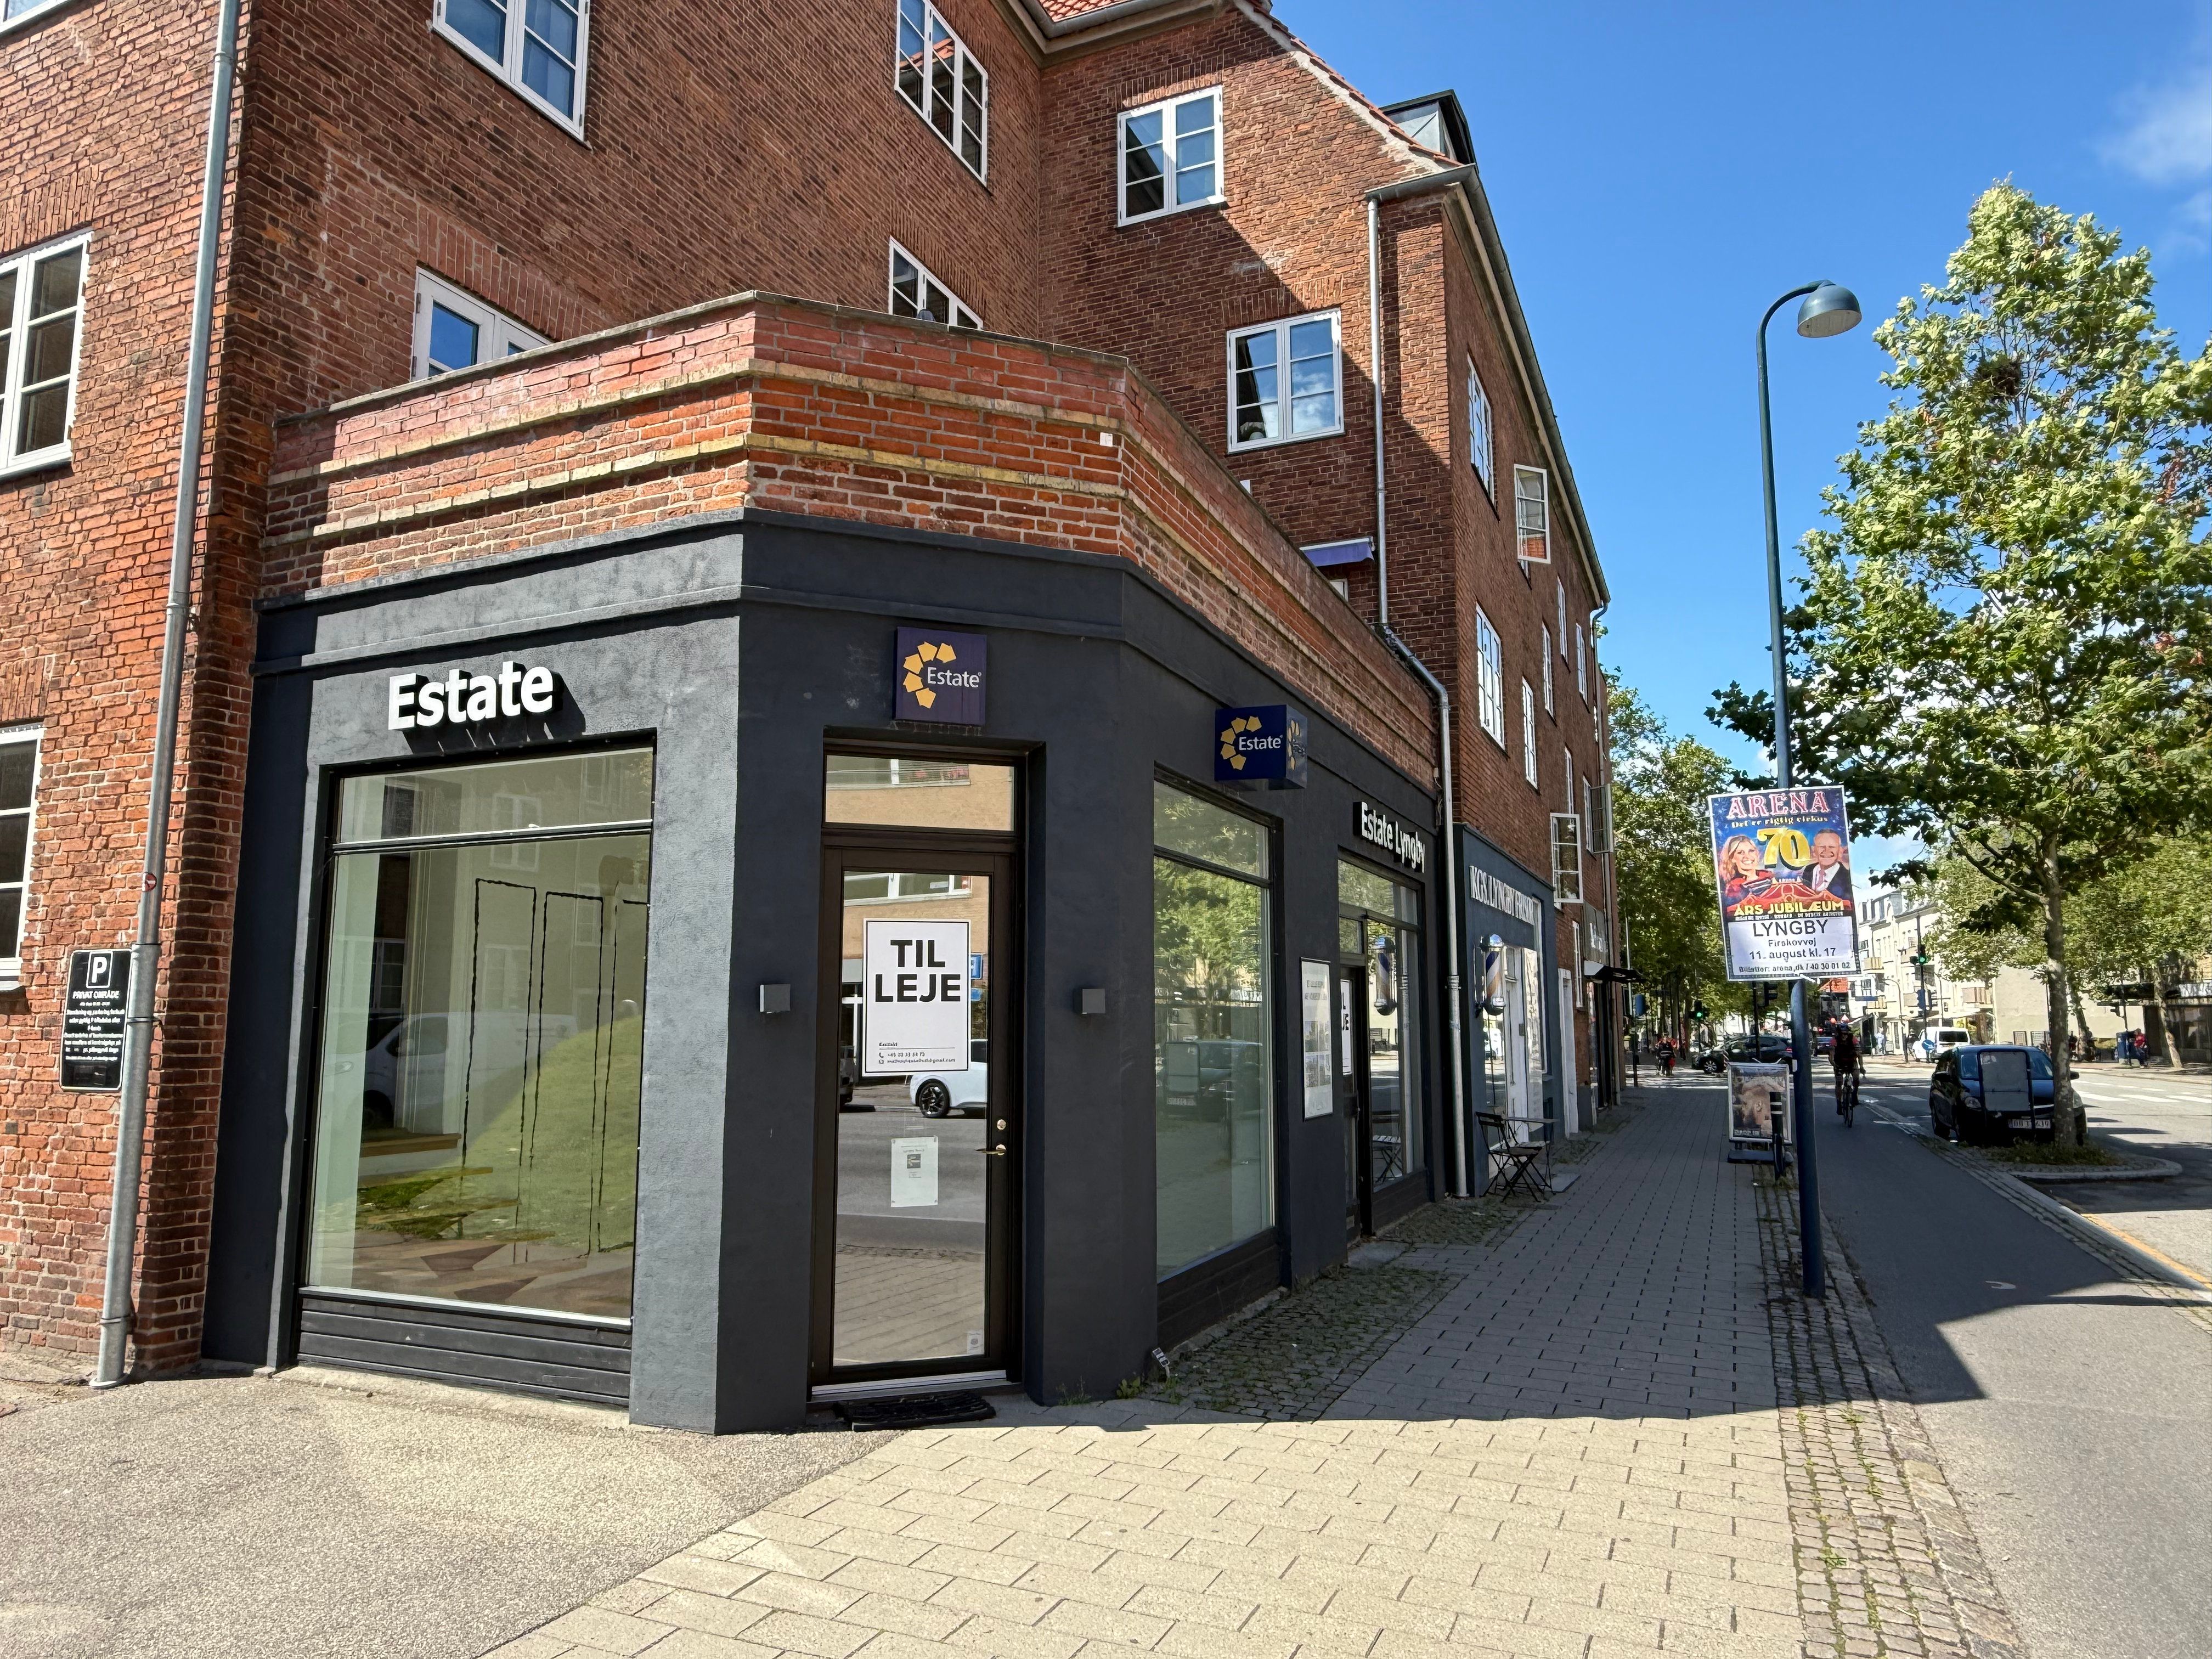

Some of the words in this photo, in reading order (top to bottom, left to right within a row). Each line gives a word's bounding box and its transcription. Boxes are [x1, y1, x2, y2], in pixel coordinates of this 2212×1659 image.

[927, 667, 980, 688] Estate
[388, 660, 554, 730] Estate
[1239, 736, 1282, 751] Estate
[1726, 791, 1831, 820] ARENA
[1361, 801, 1393, 850] Estate
[1395, 821, 1425, 873] Lyngby
[1757, 827, 1812, 871] 70
[1768, 900, 1844, 914] JUBILÆUM
[1753, 919, 1829, 937] LYNGBY
[890, 939, 946, 968] TIL
[1749, 951, 1767, 960] 11.
[1769, 949, 1807, 962] august
[1809, 948, 1822, 958] kl.
[1824, 947, 1836, 957] 17
[875, 974, 961, 1002] LEJE
